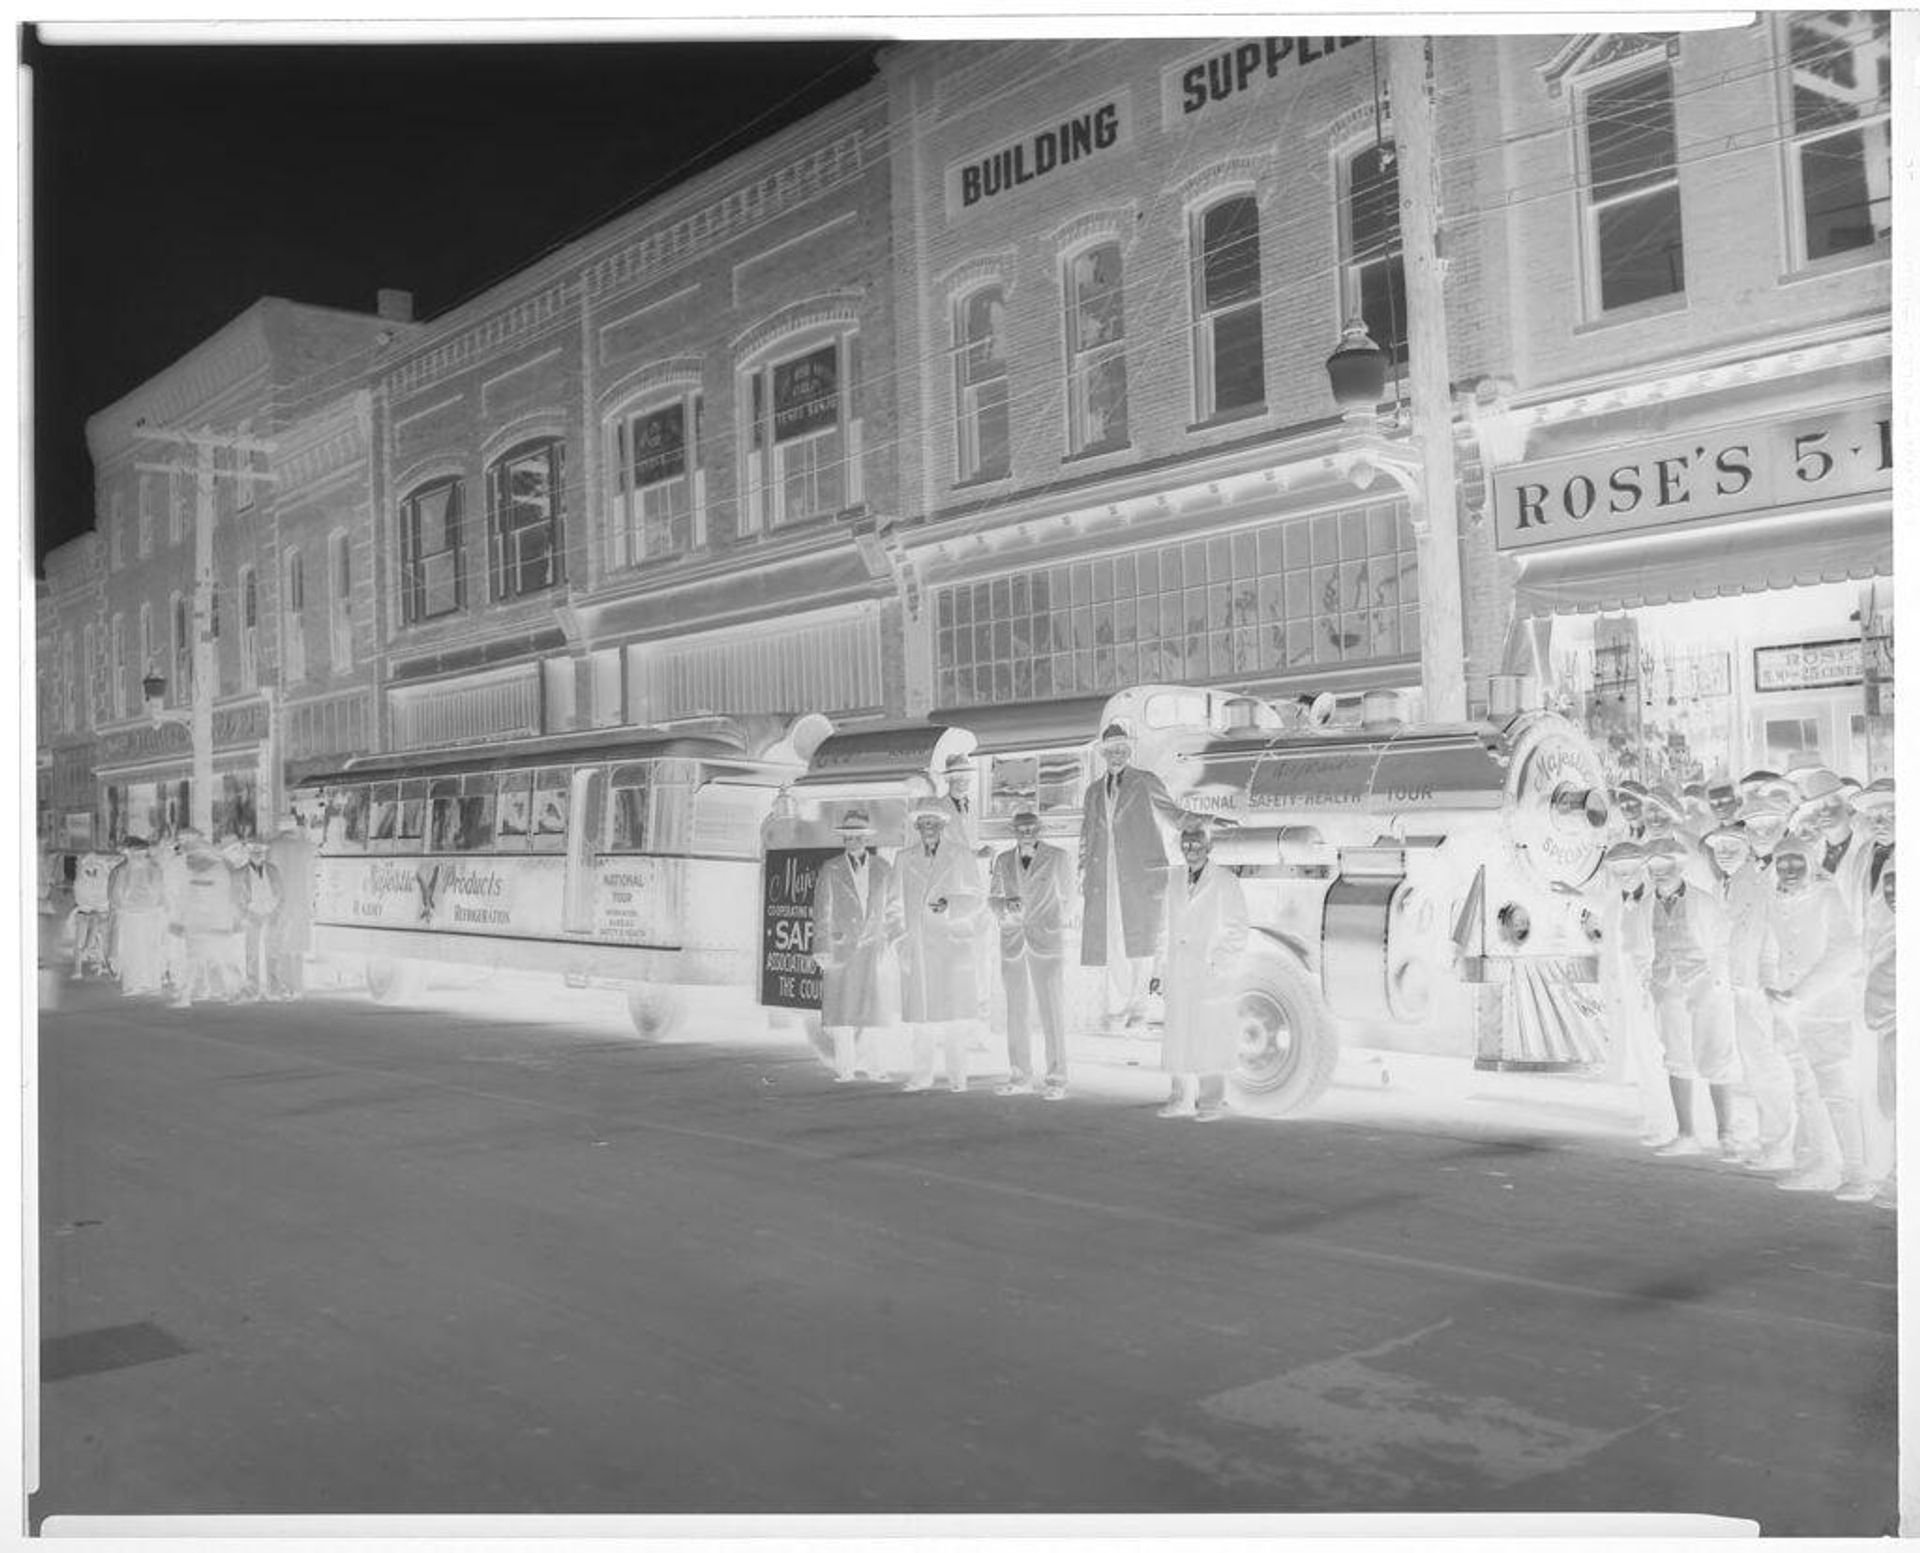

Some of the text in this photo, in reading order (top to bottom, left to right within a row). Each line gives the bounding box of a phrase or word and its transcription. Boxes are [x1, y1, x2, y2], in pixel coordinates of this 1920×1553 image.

[1183, 36, 1362, 114] SUPPL
[962, 103, 1118, 207] BUILDING
[1515, 446, 1752, 530] ROSE'S
[1386, 784, 1434, 803] TOUR
[442, 864, 504, 898] Products
[779, 976, 796, 998] THE
